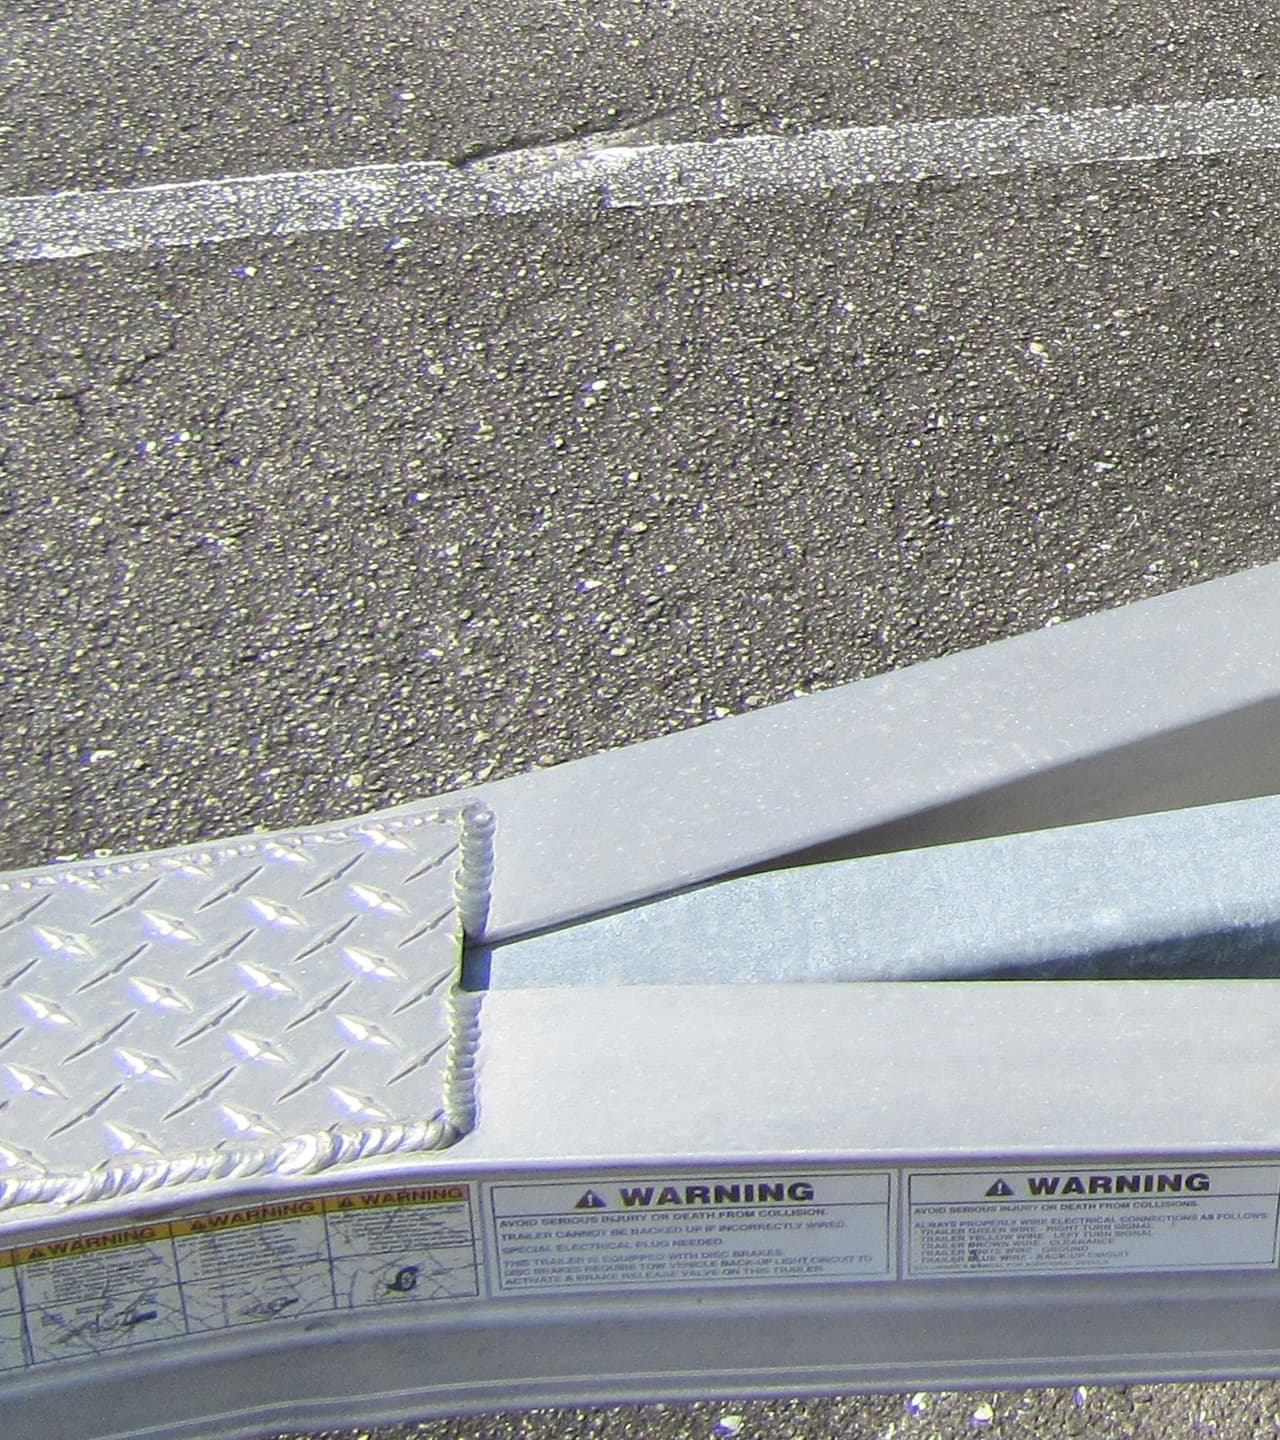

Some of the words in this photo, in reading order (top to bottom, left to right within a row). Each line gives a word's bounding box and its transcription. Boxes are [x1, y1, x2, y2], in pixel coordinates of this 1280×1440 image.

[1027, 1172, 1211, 1196] WARNING
[359, 1188, 464, 1203] WARNING
[619, 1182, 815, 1207] WARNING
[207, 1201, 315, 1224] WARNING
[914, 1207, 946, 1215] AVOID
[949, 1205, 997, 1213] SERIOUS
[1060, 1203, 1096, 1211] DEATH
[499, 1219, 537, 1227] AVOID
[542, 1217, 597, 1225] SERIOUS
[602, 1215, 646, 1223] INJURY
[673, 1210, 715, 1220] DEATH
[720, 1210, 755, 1218] FROM
[1051, 1216, 1116, 1225] ELECTRICAL
[556, 1230, 606, 1238] CANNOT
[611, 1228, 627, 1236] BE
[631, 1227, 682, 1235] BACKED
[720, 1222, 802, 1231] INCORRECTLY
[48, 1226, 155, 1253] WARNING
[556, 1242, 631, 1252] ELECTRICAL
